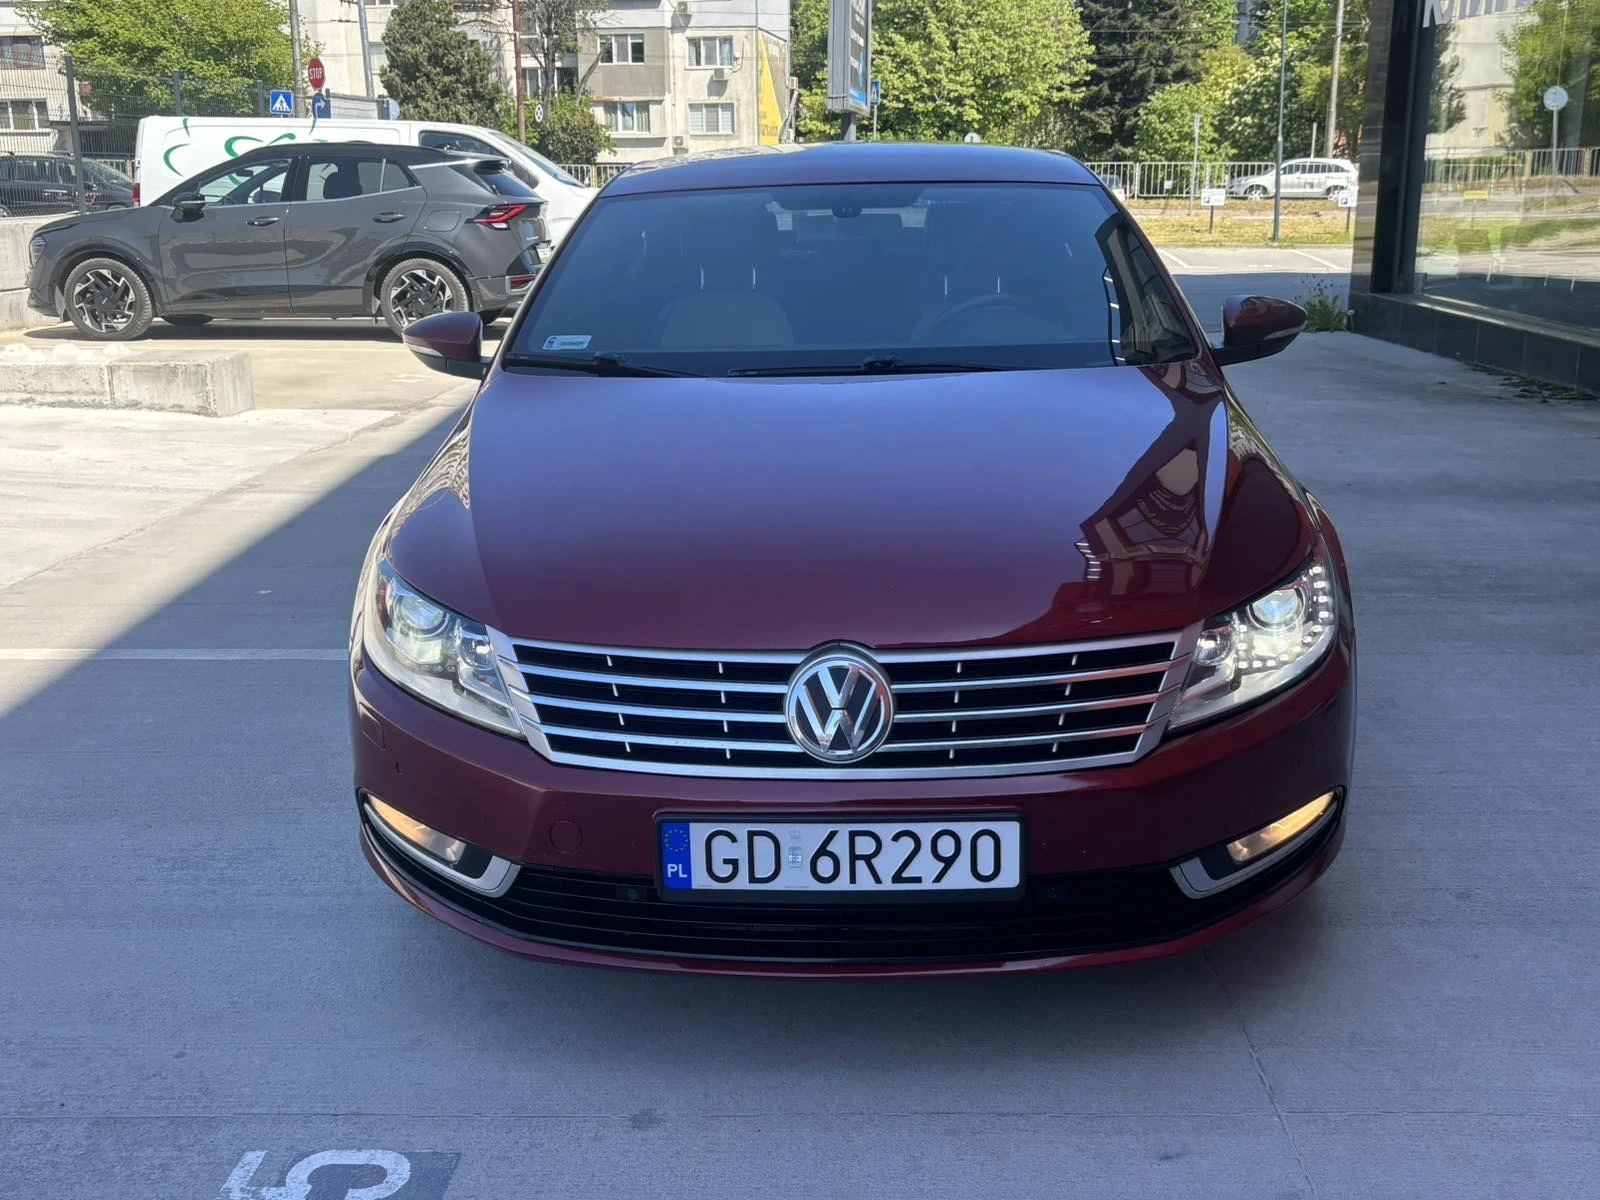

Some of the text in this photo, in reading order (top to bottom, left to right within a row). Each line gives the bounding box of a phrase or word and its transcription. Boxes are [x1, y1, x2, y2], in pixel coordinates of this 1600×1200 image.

[309, 67, 323, 80] STOP
[790, 661, 888, 755] VW
[667, 864, 688, 878] PL
[705, 828, 1002, 885] GD 6R290
